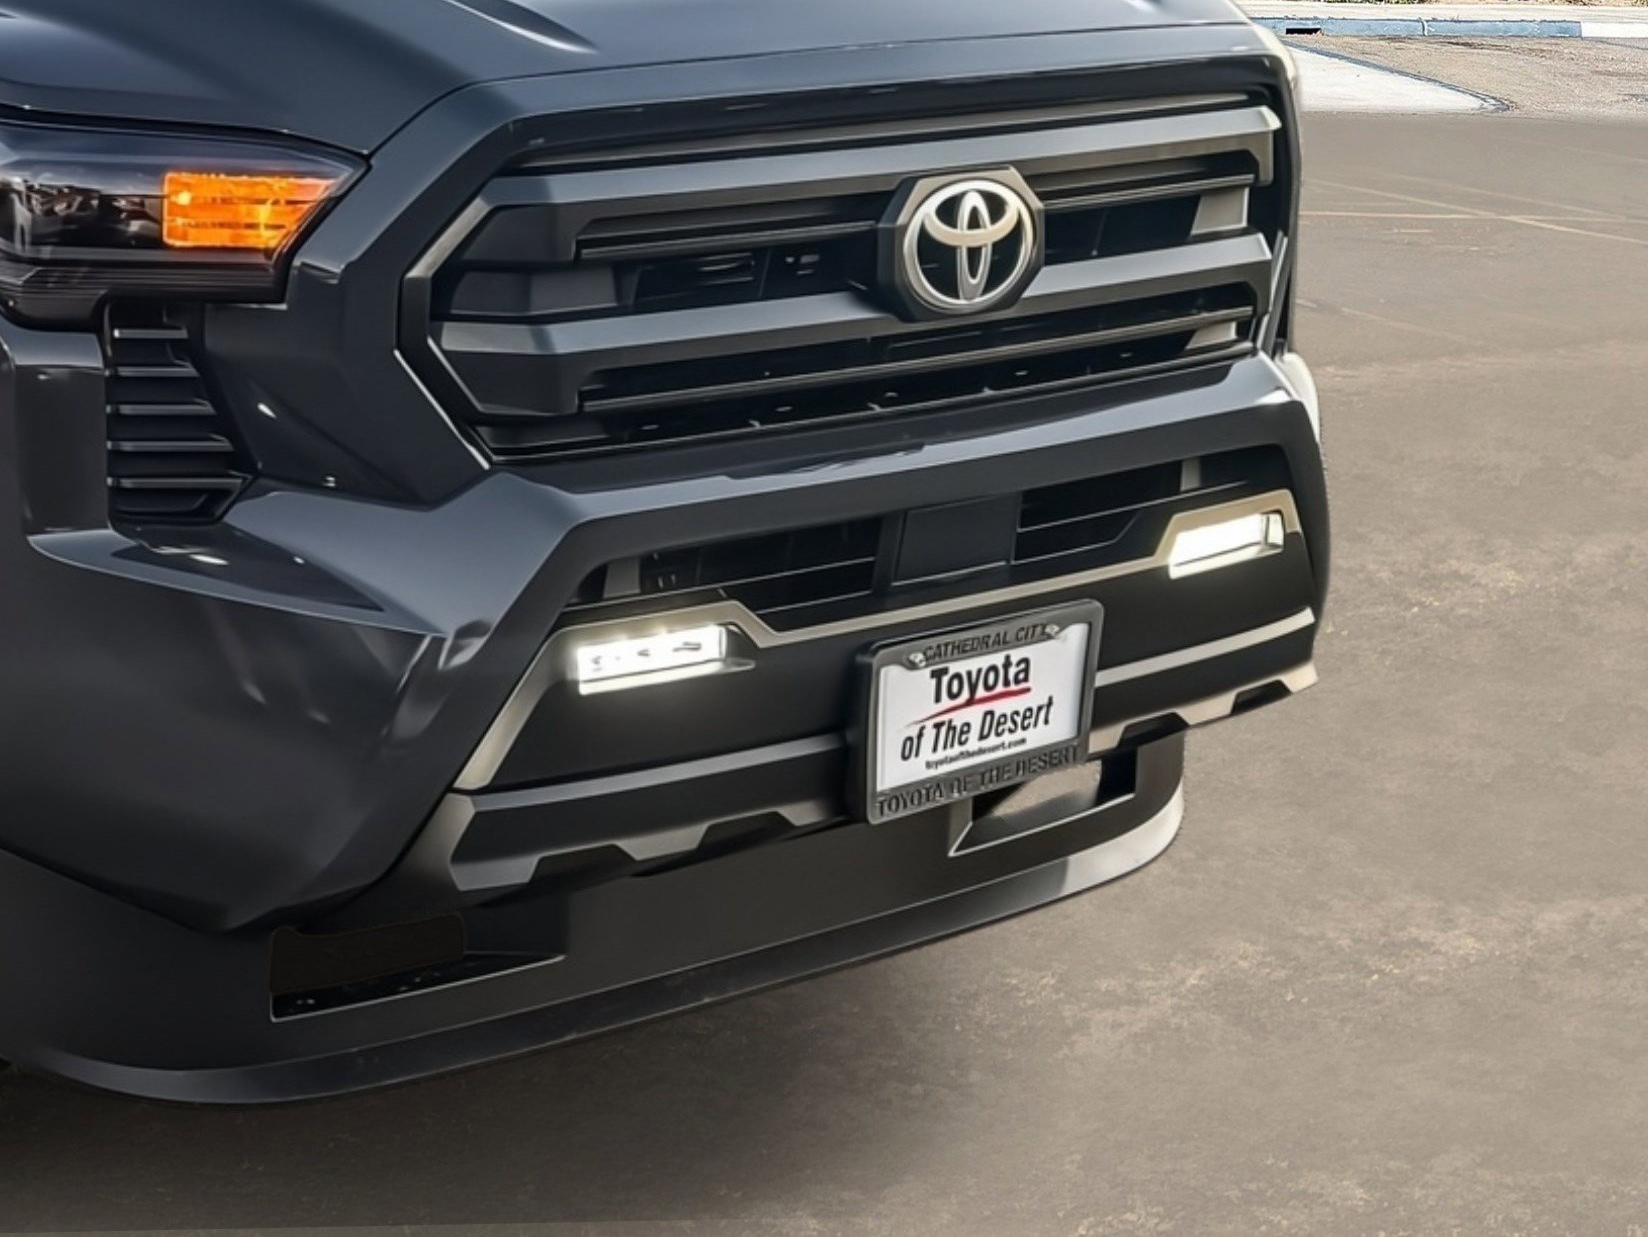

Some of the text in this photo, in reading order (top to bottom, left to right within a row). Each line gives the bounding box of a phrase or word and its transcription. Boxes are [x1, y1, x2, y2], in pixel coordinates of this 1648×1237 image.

[923, 631, 1010, 661] CATHEDRAL
[930, 653, 1031, 705] Toyota
[901, 695, 1054, 761] of The Desert
[877, 782, 945, 817] TOYOTA
